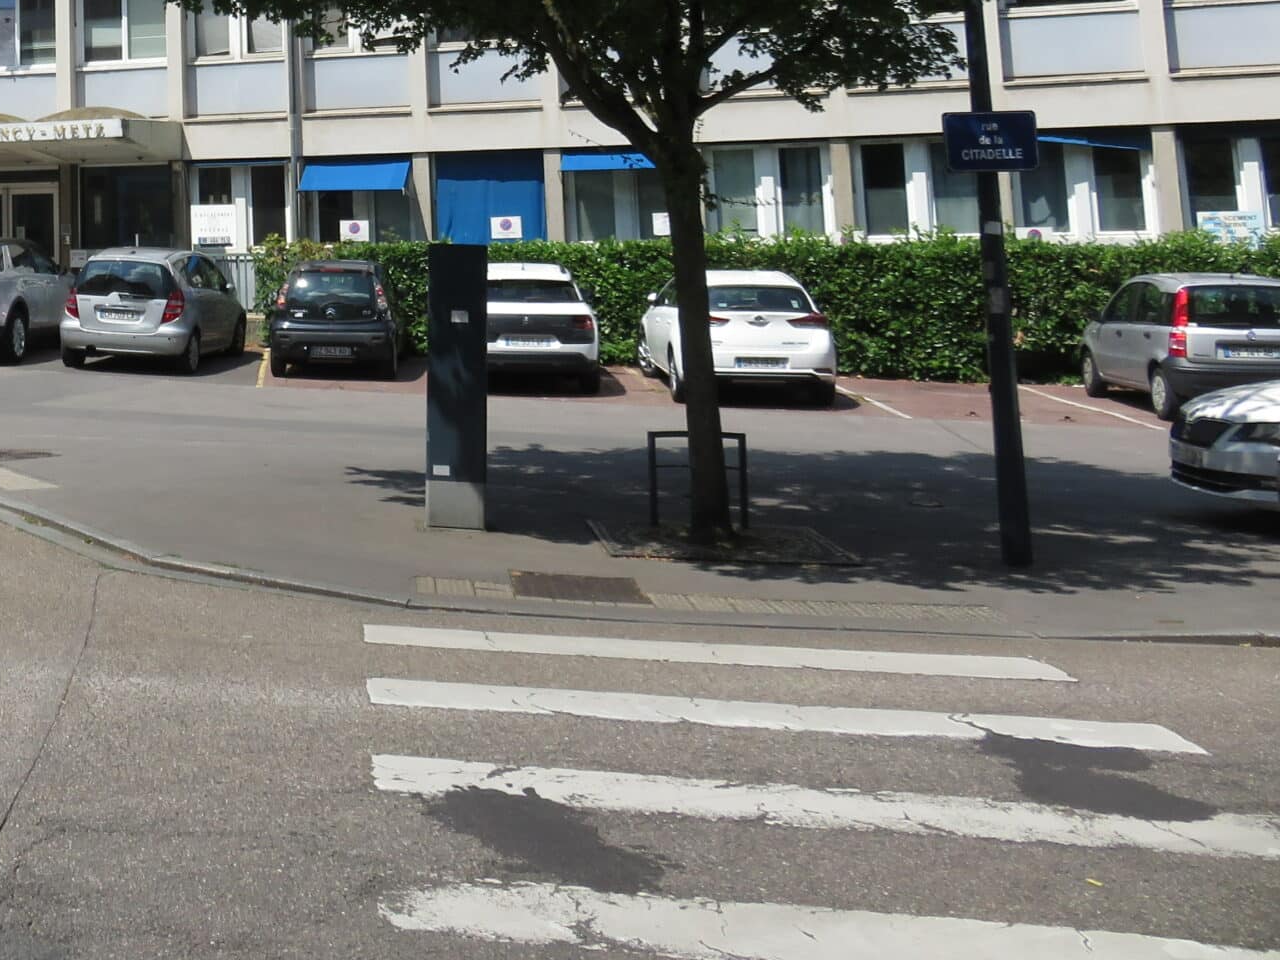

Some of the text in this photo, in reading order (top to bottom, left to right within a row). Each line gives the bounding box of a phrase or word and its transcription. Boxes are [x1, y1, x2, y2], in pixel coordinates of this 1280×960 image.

[981, 122, 999, 131] rue
[978, 135, 1004, 145] de la
[961, 147, 1024, 161] CITADELLE
